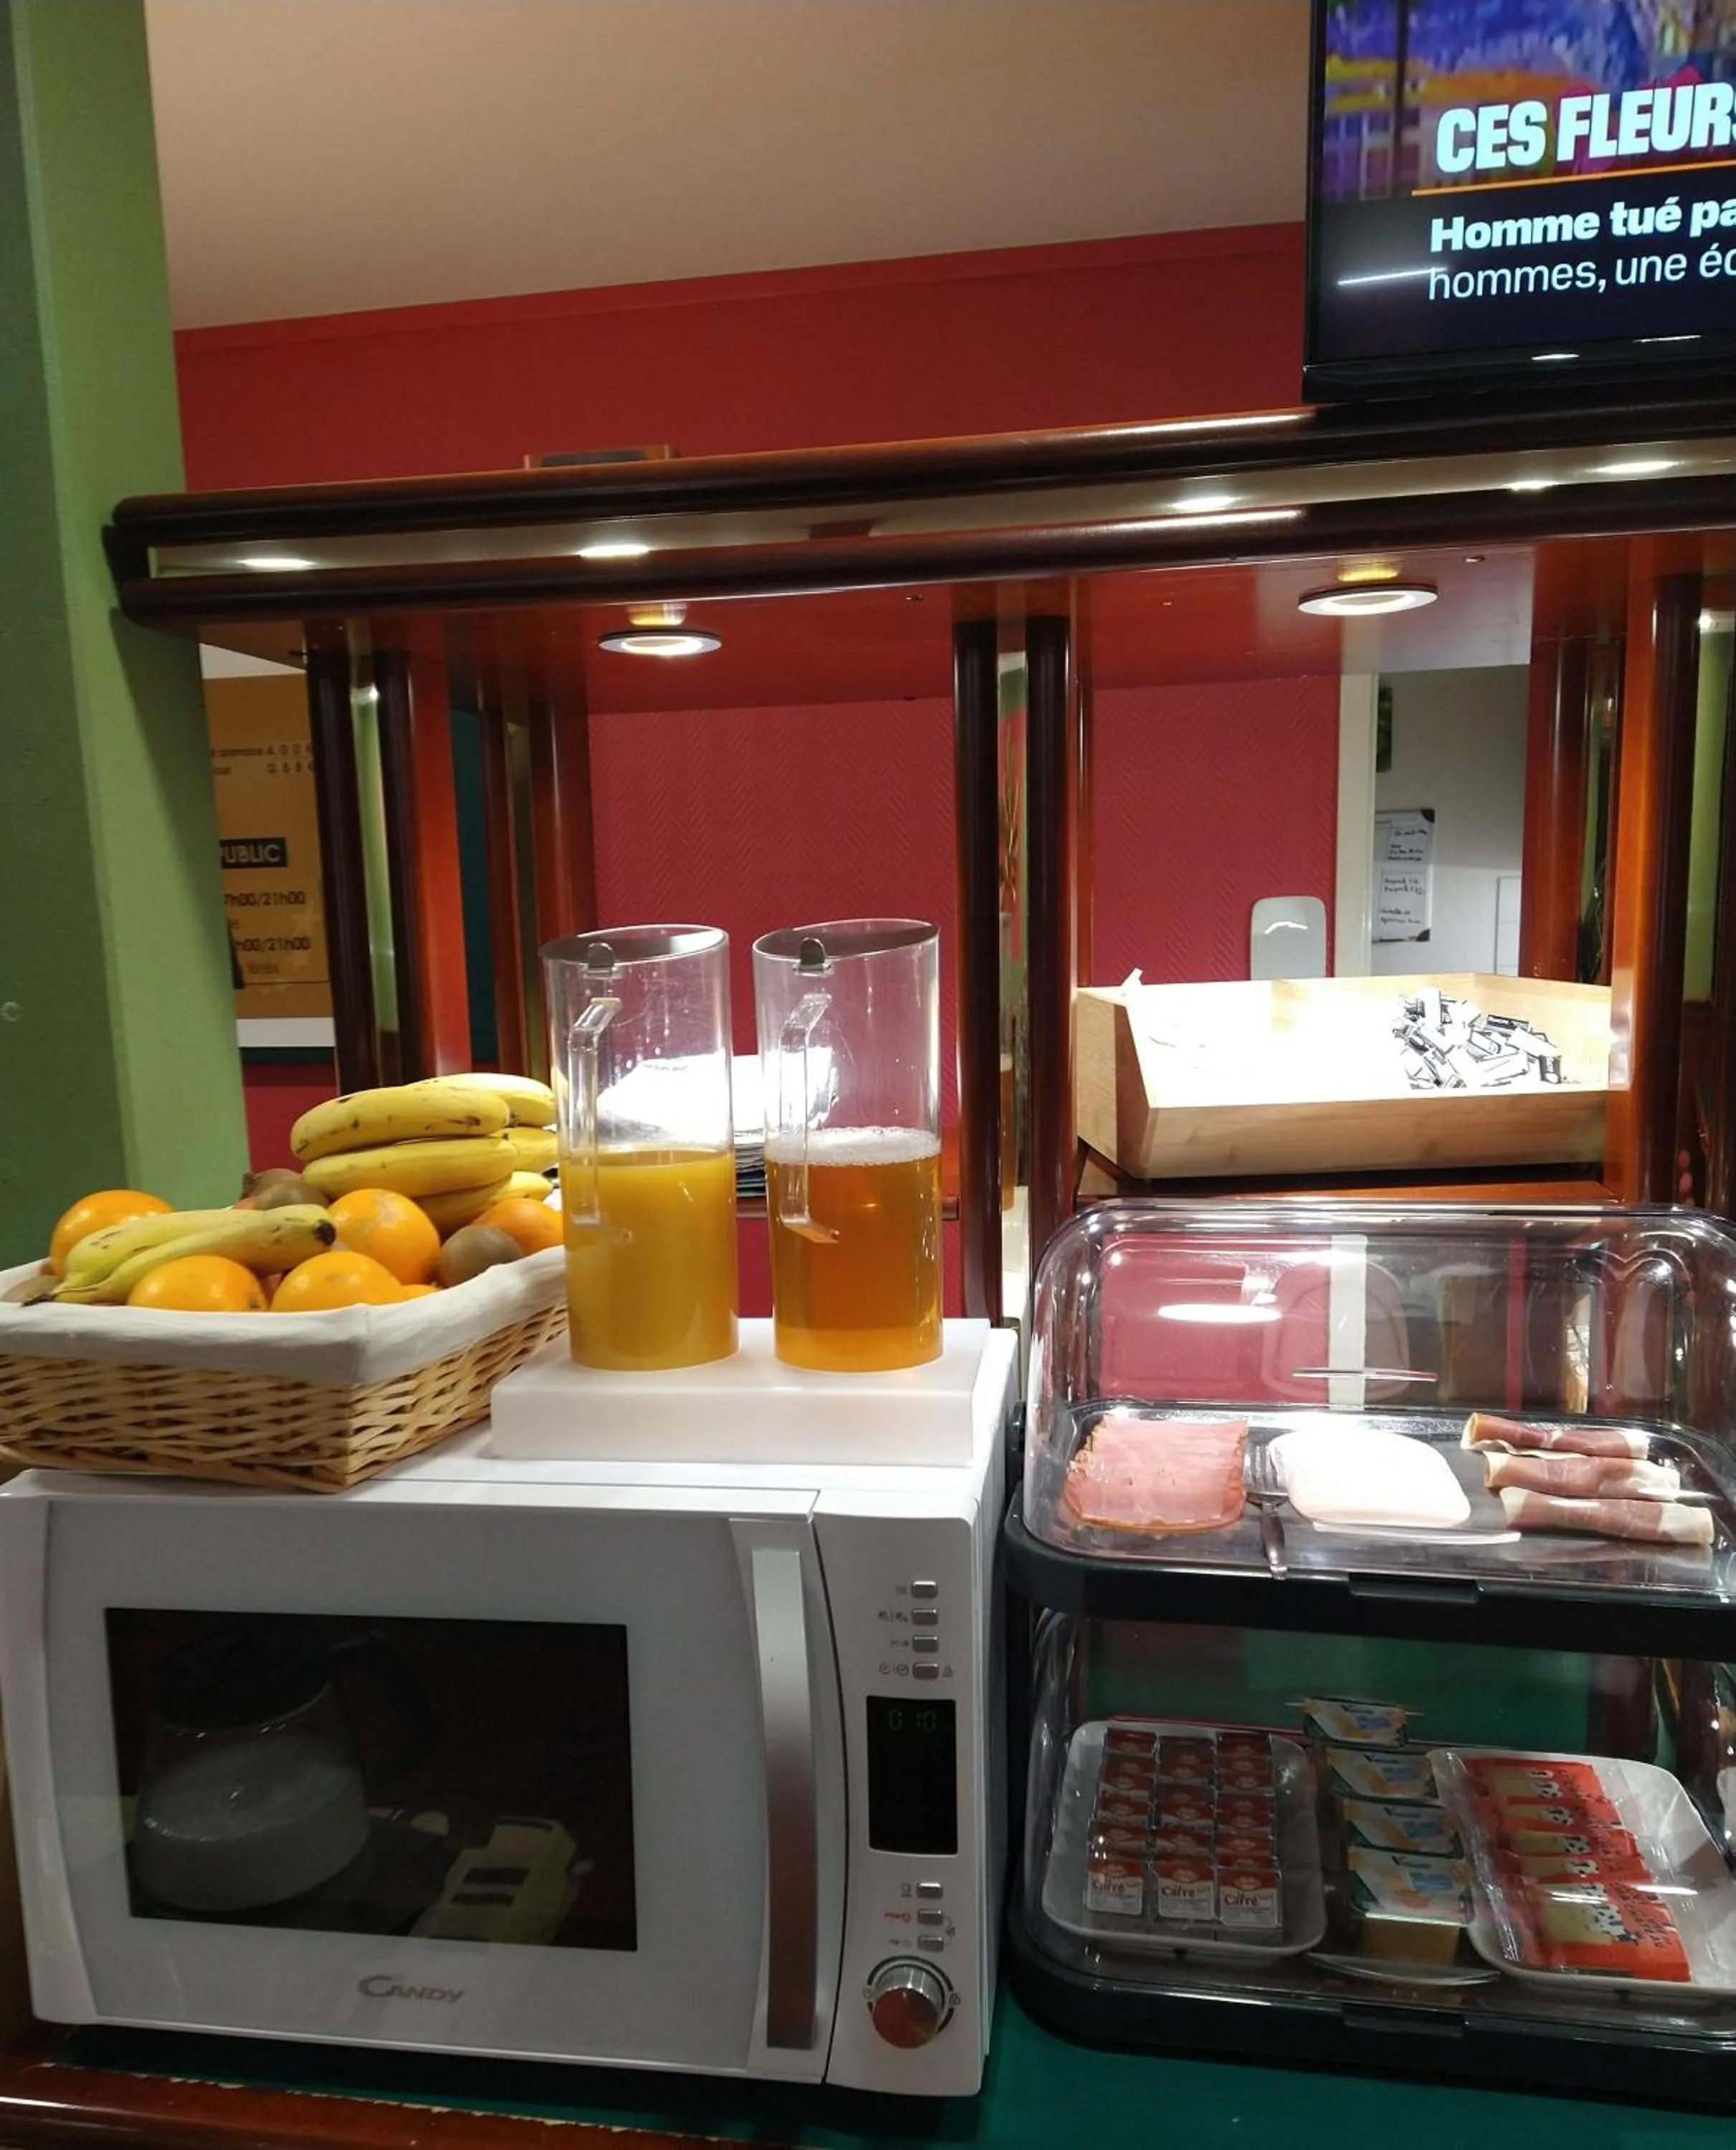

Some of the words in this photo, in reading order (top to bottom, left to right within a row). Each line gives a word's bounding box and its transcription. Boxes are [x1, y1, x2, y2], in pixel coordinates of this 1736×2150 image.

[1436, 100, 1548, 173] CES
[1555, 82, 1736, 162] FLEUR
[1430, 212, 1600, 252] Homme
[1609, 196, 1682, 236] tué
[1428, 260, 1607, 300] hommes,
[1615, 252, 1687, 286] une
[223, 844, 281, 863] UBLIC
